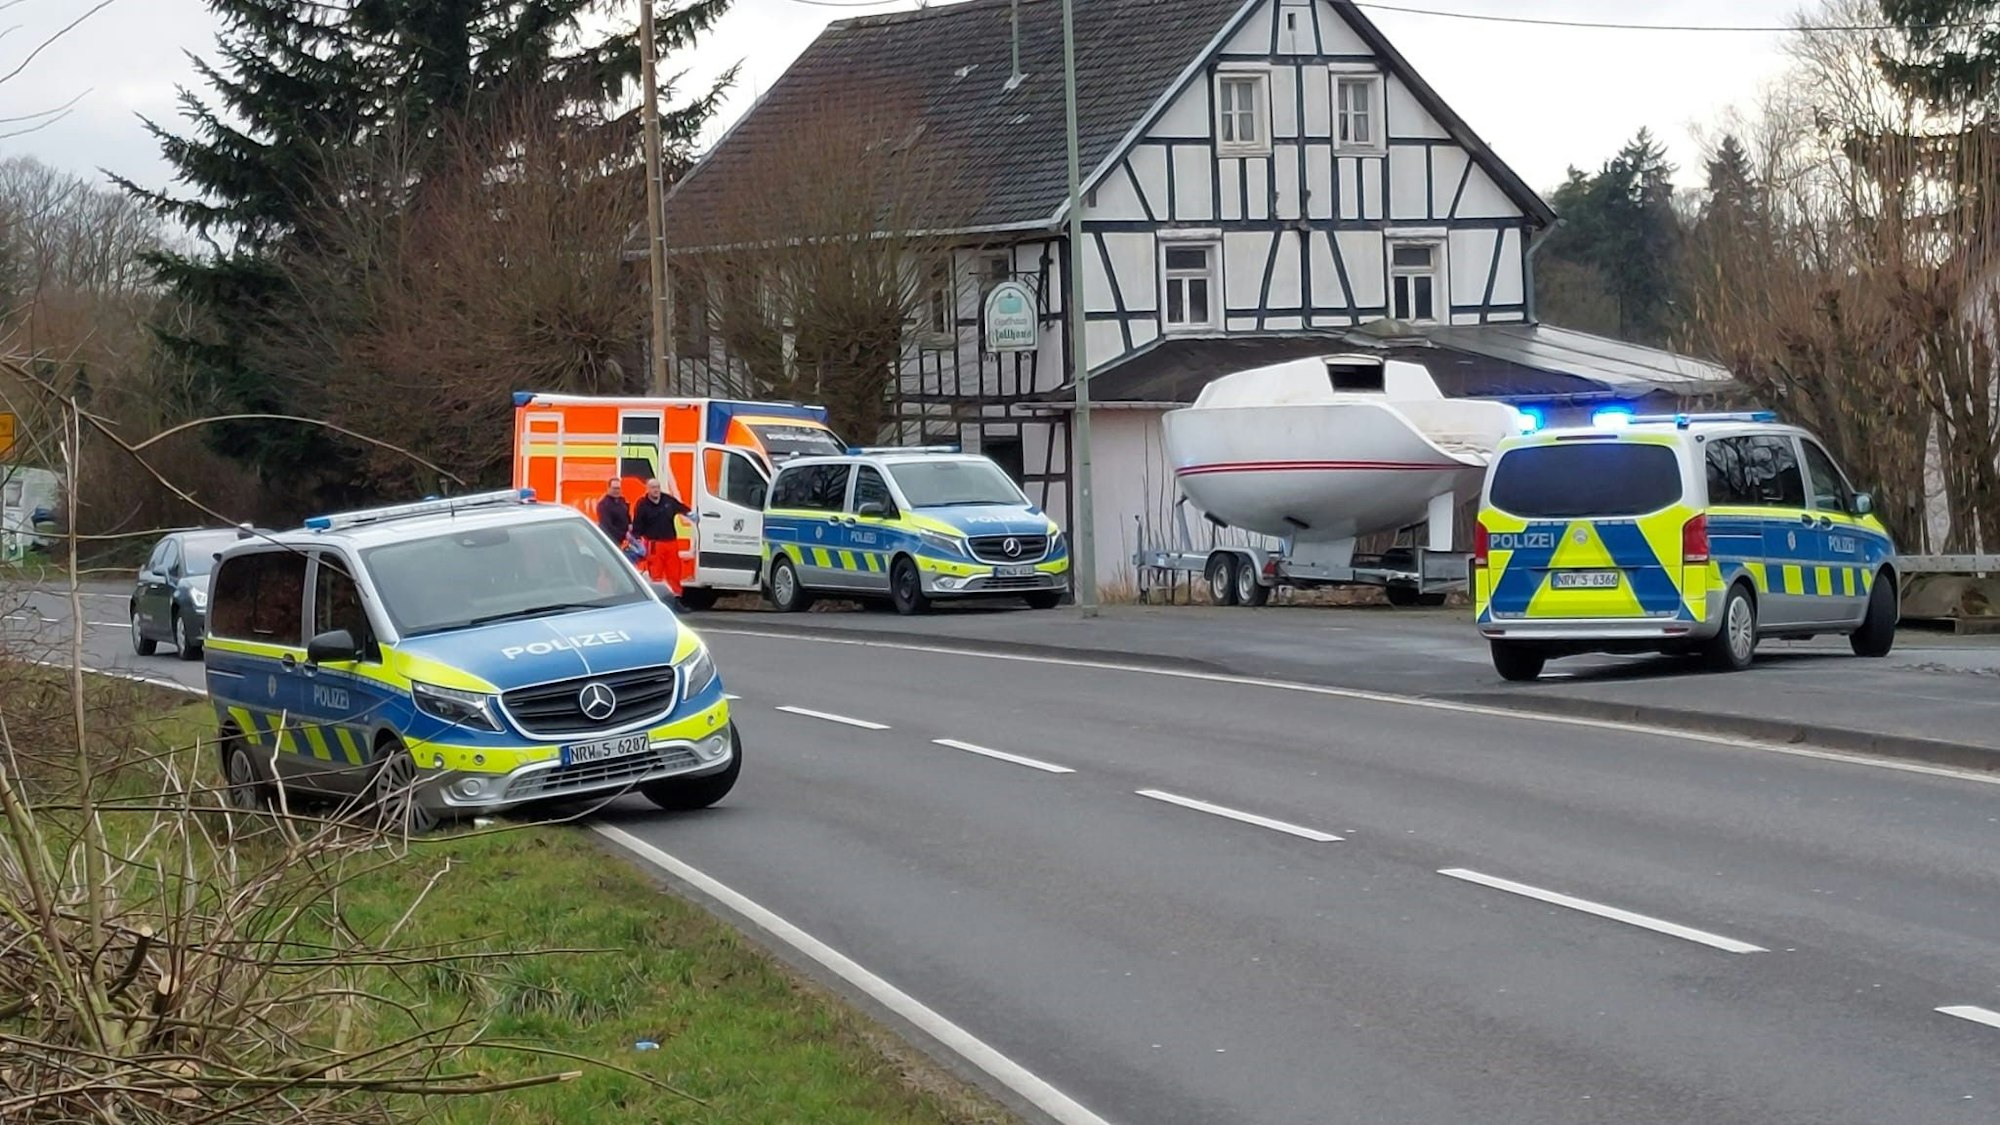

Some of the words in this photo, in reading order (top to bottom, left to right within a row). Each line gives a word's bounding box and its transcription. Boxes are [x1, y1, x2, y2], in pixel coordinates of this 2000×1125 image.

[1491, 533, 1554, 548] POLIZEI
[1828, 535, 1855, 553] POLIZEI
[501, 630, 631, 660] POLIZEI
[314, 684, 350, 710] POLIZEI
[570, 744, 596, 762] NRW
